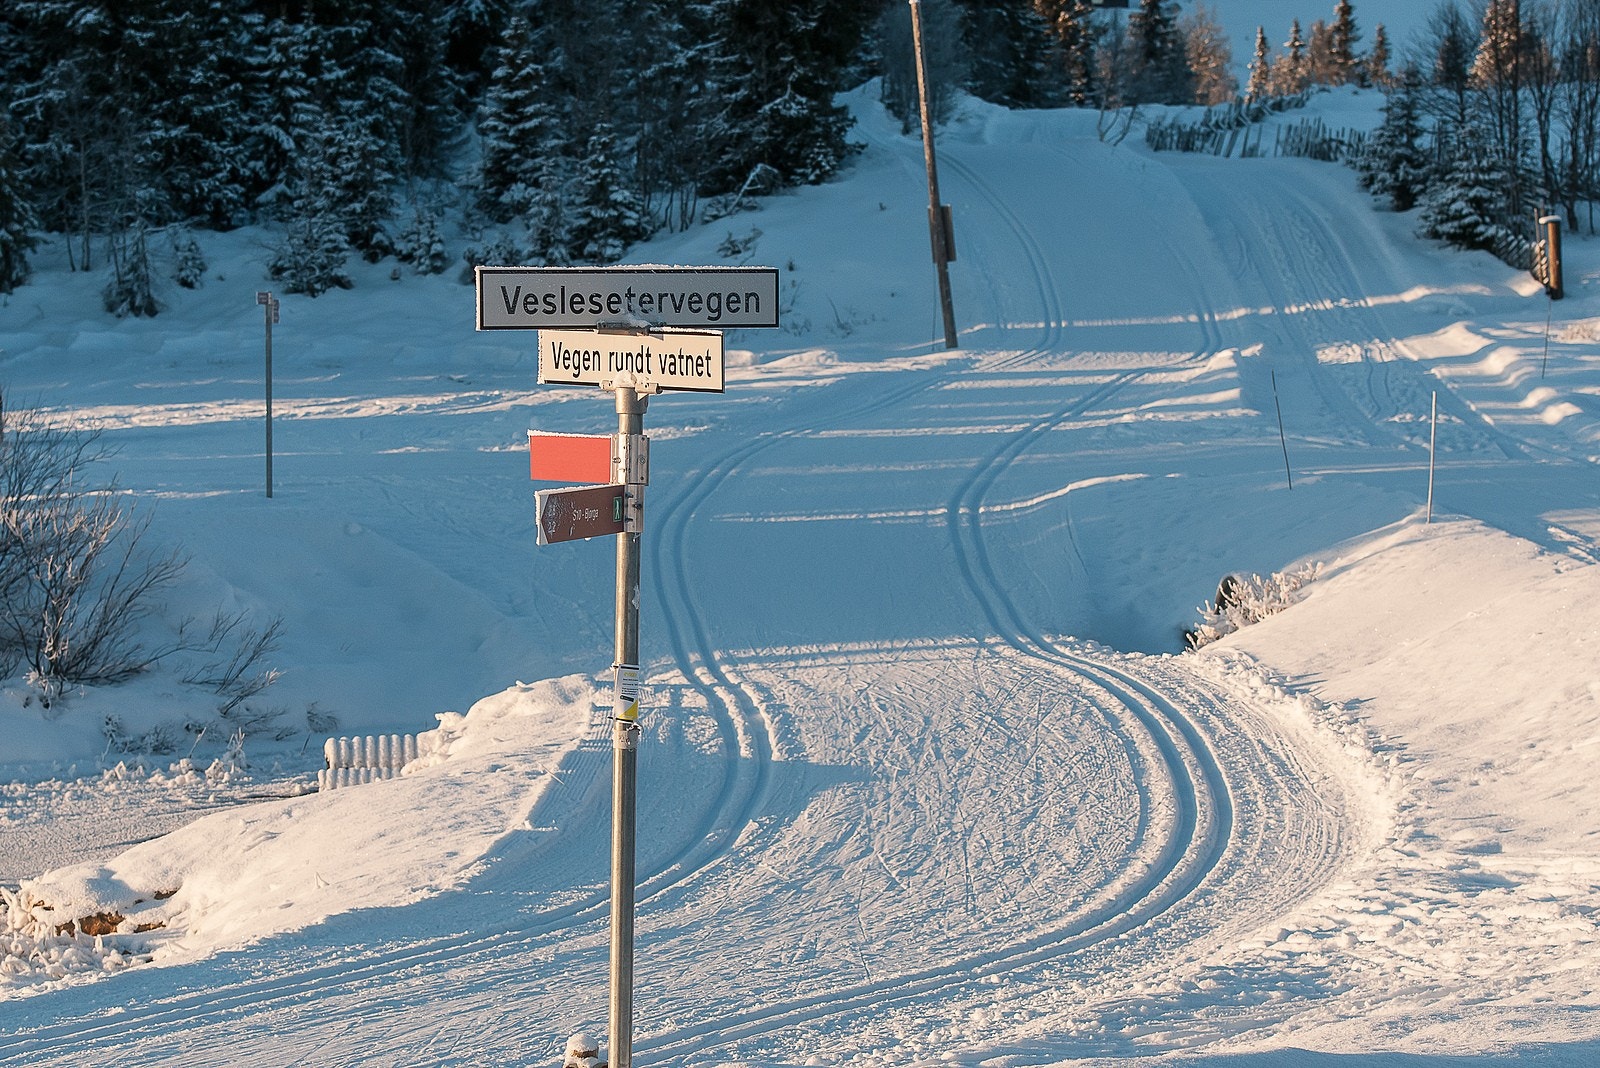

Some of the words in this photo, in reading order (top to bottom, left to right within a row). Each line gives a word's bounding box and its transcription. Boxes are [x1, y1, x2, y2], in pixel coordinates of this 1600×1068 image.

[500, 285, 761, 321] Veslesetervegen
[551, 341, 601, 378] Vegen
[608, 344, 652, 375] rundt
[658, 347, 712, 378] vatnet
